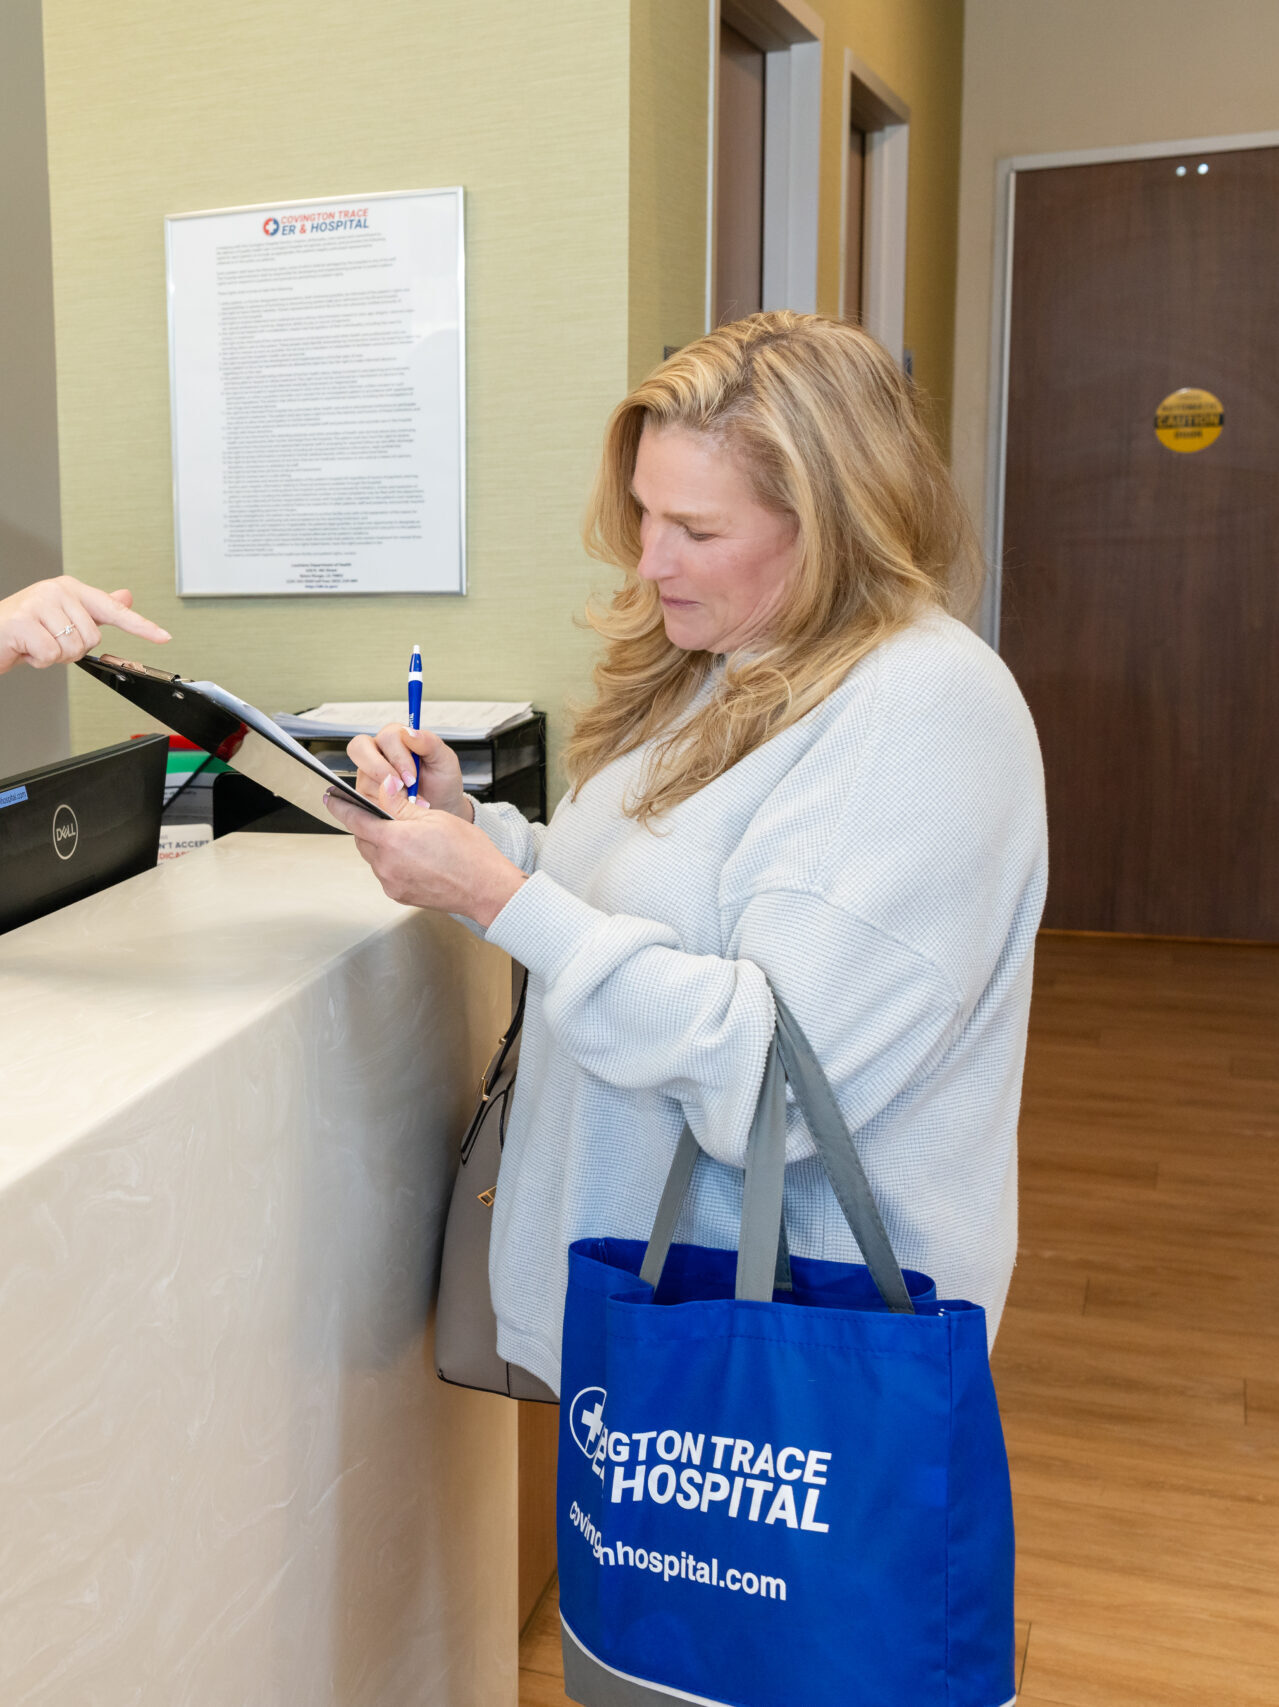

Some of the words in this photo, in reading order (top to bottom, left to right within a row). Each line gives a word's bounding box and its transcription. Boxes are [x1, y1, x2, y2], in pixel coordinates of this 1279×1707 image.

[280, 211, 336, 224] COVINGTON
[338, 208, 369, 219] TRACE
[281, 224, 297, 236] ER
[299, 223, 307, 234] &
[310, 218, 369, 233] HOSPITAL
[56, 823, 76, 842] DELL
[710, 1435, 833, 1486] TRACE
[610, 1463, 830, 1534] HOSPITAL
